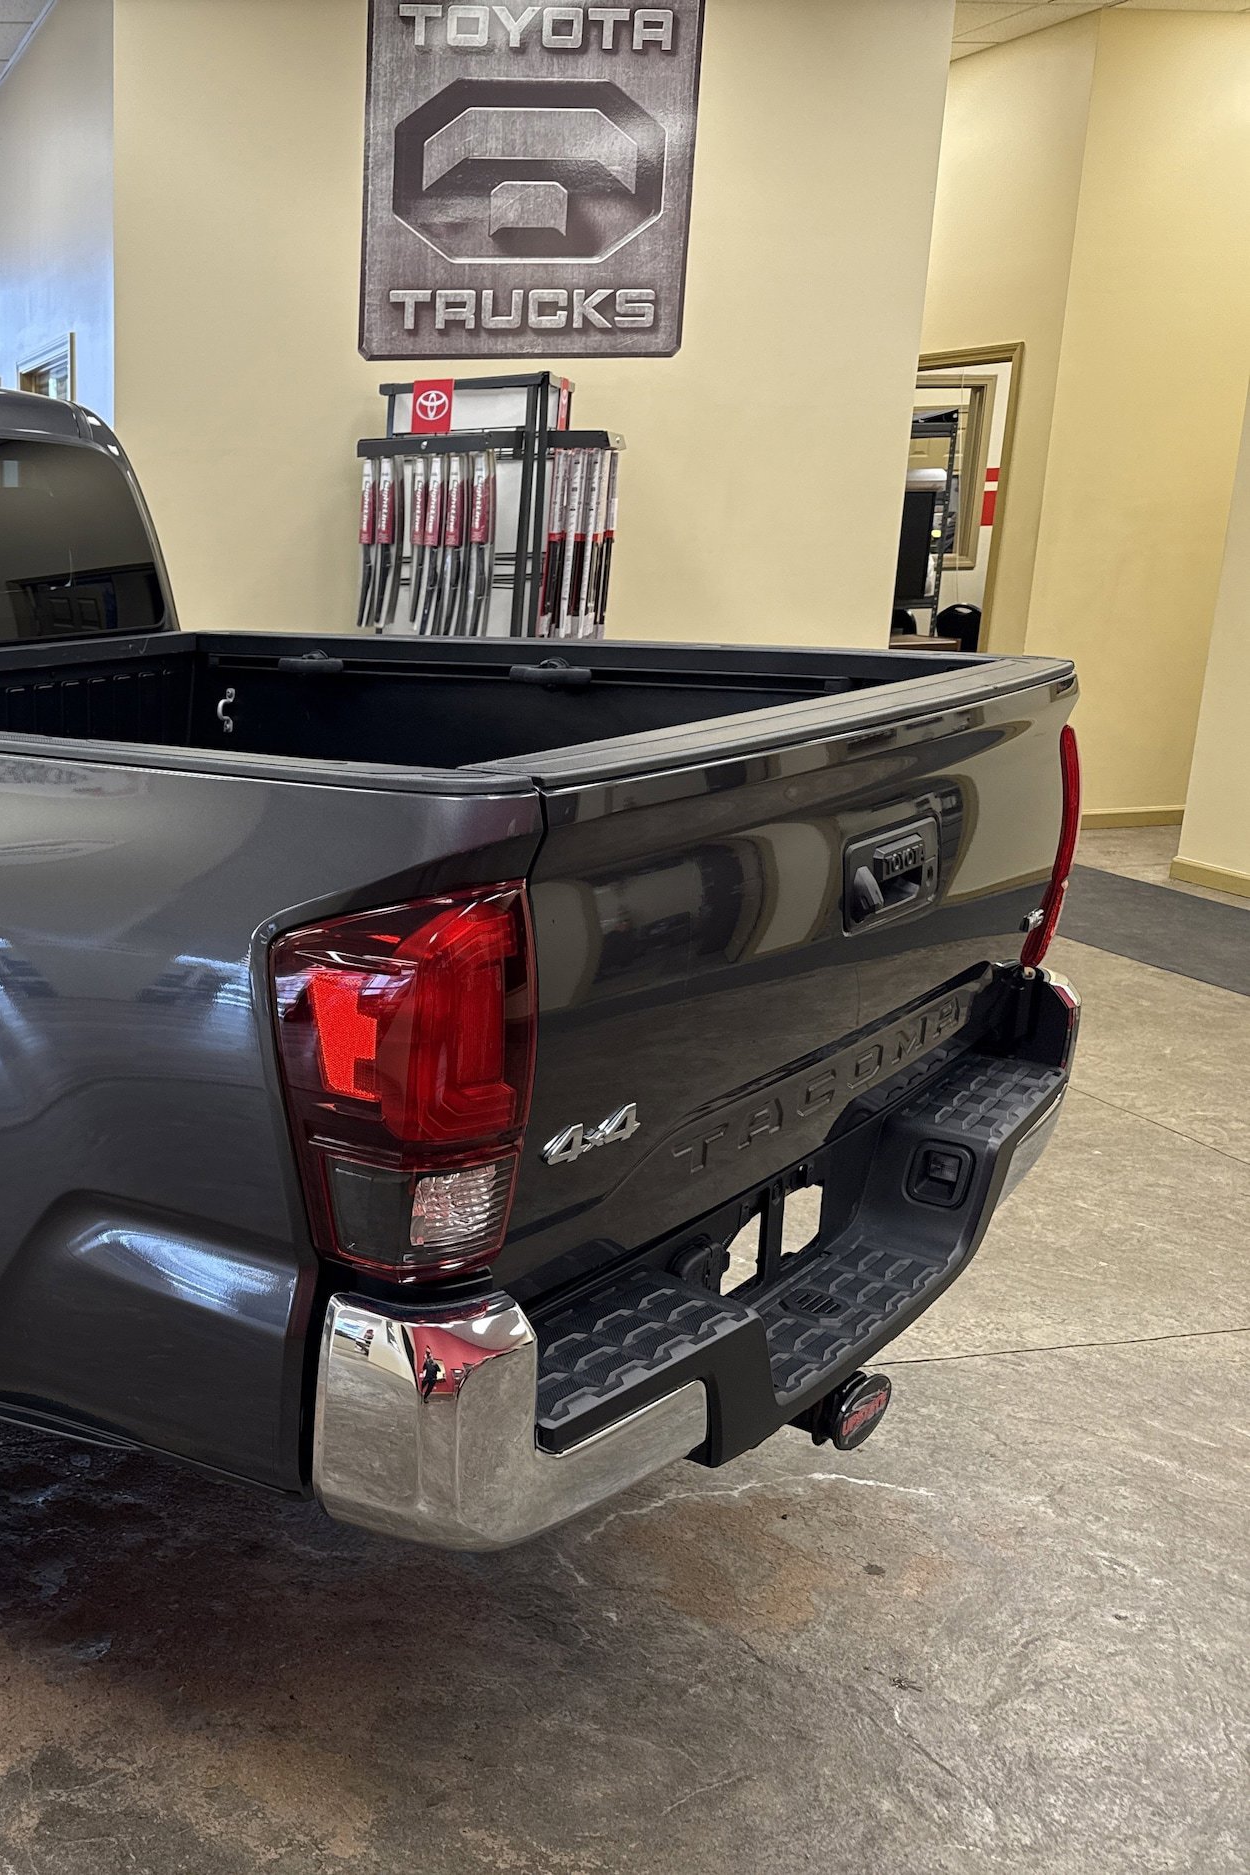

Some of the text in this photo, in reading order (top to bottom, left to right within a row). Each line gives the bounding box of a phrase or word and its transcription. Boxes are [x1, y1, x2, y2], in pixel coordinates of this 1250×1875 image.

[399, 4, 674, 51] TOYOTA
[389, 288, 656, 331] TRUCKS
[883, 843, 925, 876] TOYOTA
[672, 996, 960, 1174] TACOMA
